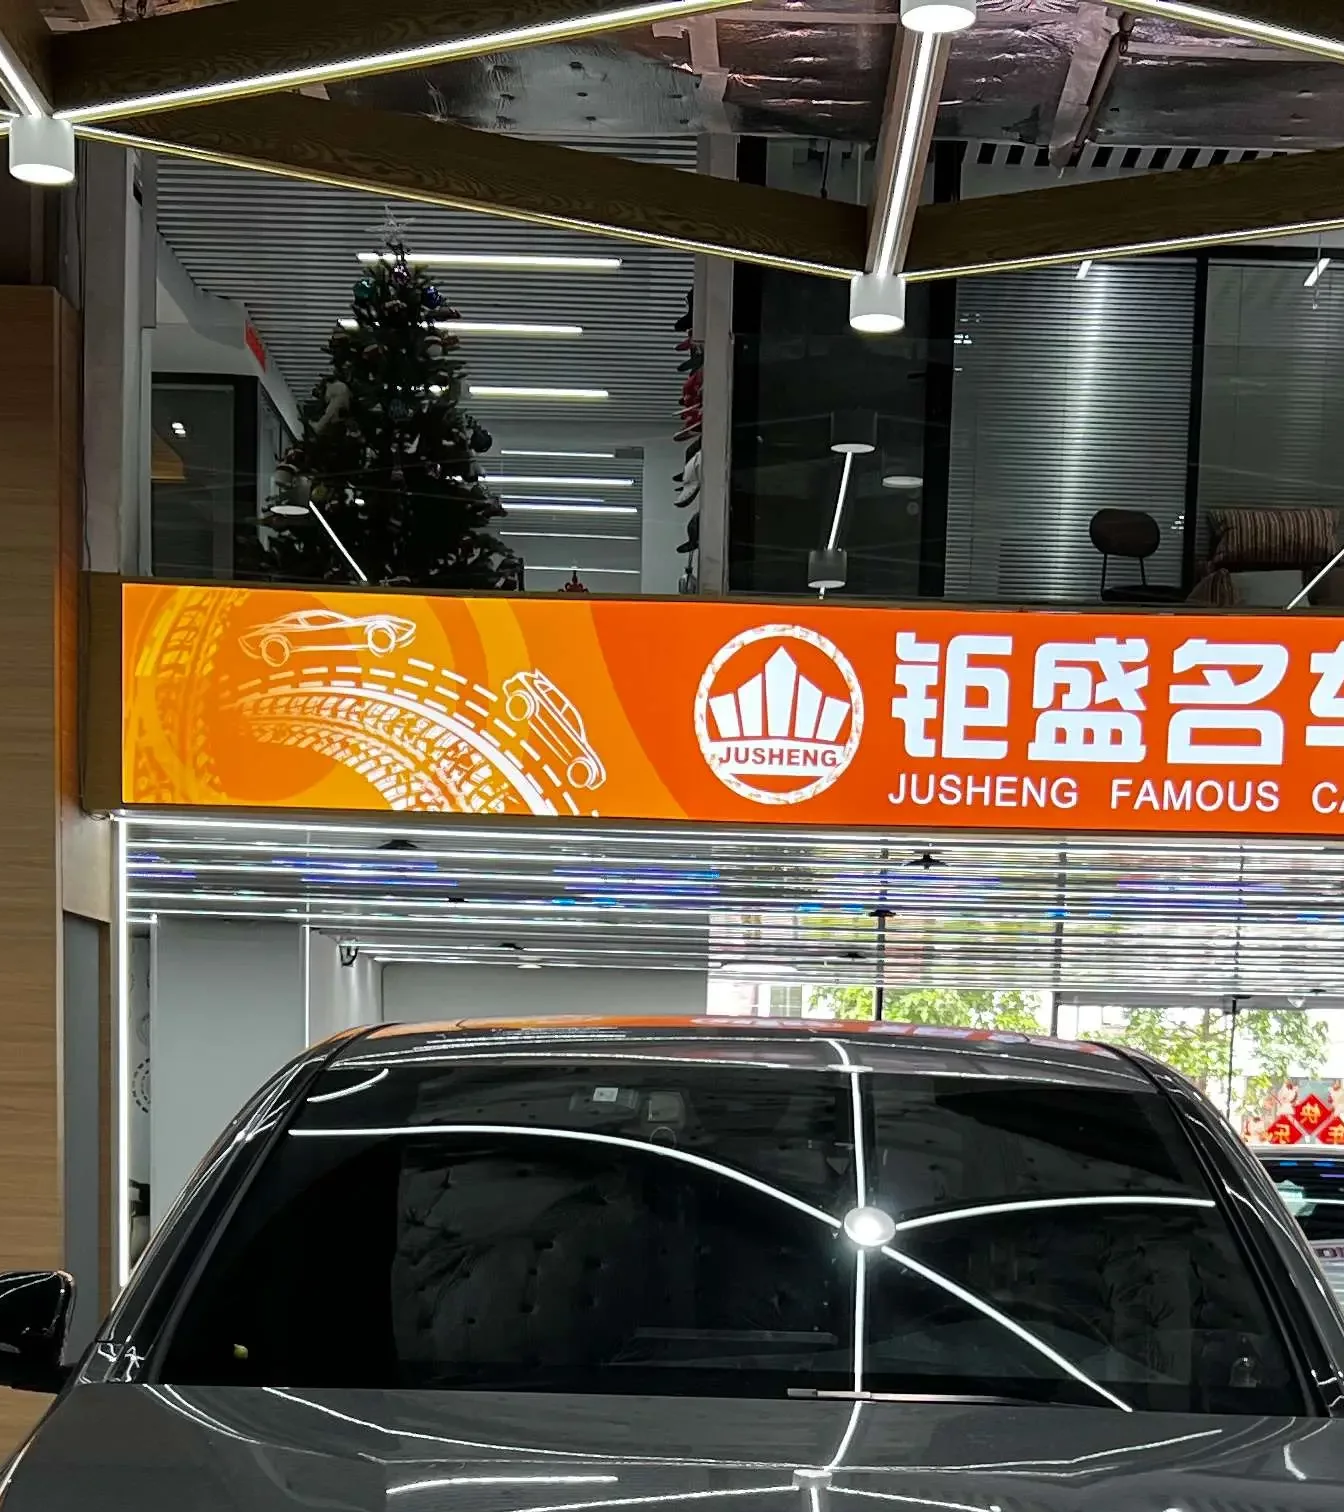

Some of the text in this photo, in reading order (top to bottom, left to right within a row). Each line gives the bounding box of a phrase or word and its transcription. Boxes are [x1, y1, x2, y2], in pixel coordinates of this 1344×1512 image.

[718, 746, 840, 768] JUSHENG
[888, 773, 1080, 810] JUSHENG
[1110, 777, 1281, 814] FAMOUS
